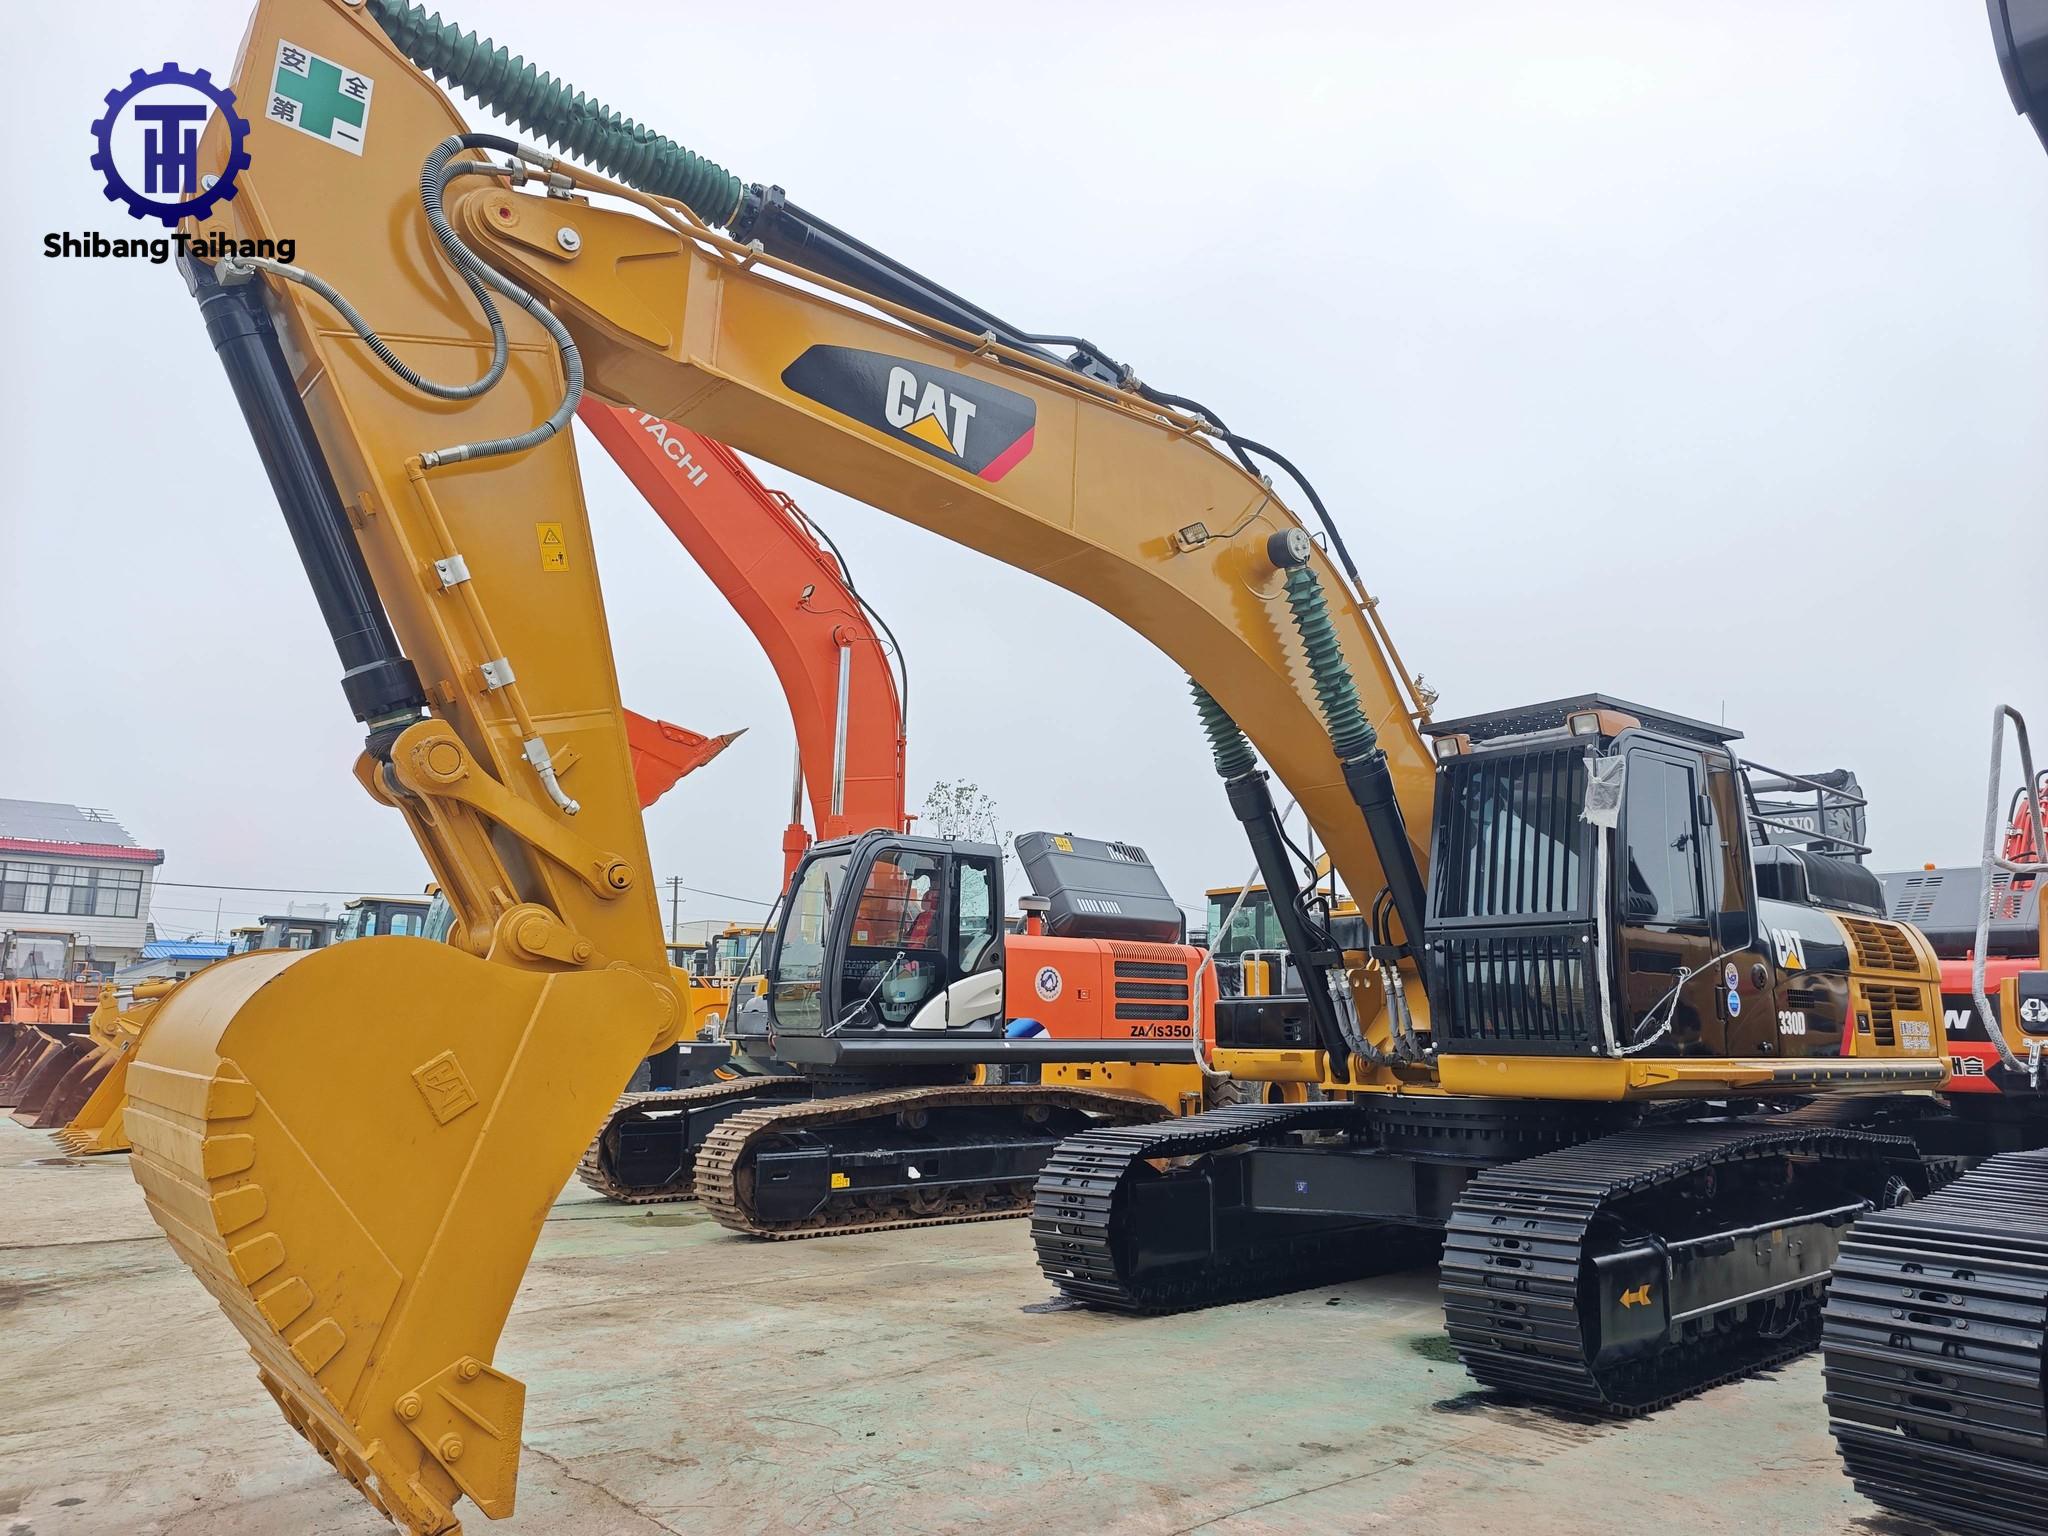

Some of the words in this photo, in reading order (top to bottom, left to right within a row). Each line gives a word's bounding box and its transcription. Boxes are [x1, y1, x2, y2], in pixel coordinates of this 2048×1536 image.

[885, 366, 977, 459] CAT
[628, 407, 709, 487] TACHI
[1771, 927, 1807, 970] CAT
[1778, 1010, 1806, 1035] 330D
[422, 1058, 474, 1117] CAT
